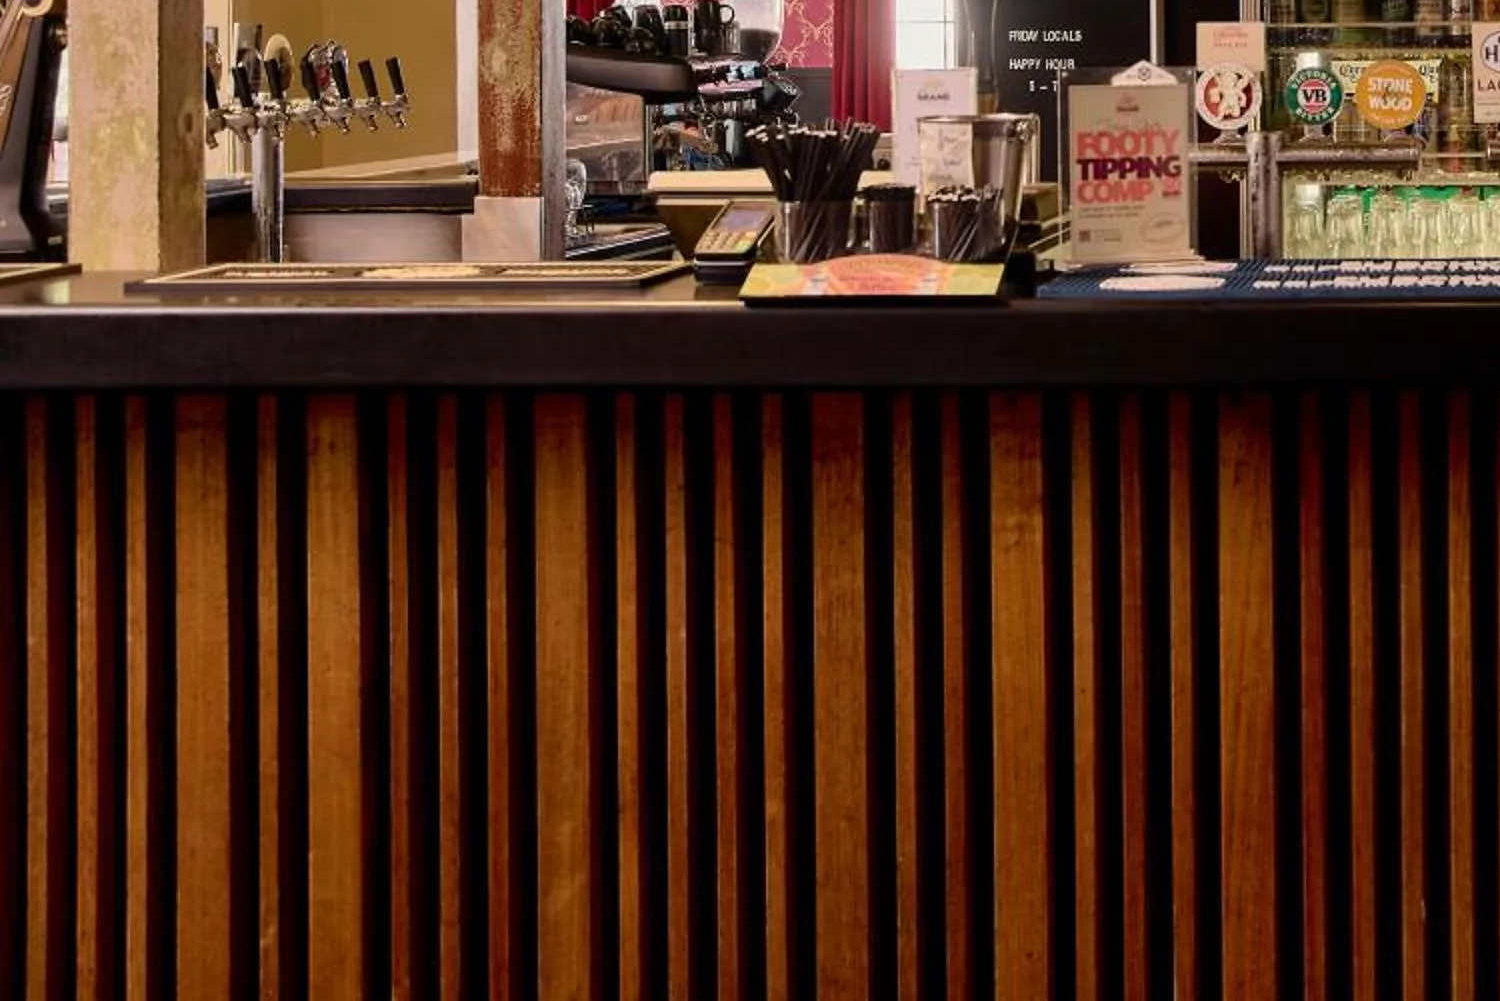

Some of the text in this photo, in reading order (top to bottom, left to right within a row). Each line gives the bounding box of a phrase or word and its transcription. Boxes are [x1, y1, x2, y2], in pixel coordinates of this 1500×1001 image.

[1043, 30, 1083, 42] LOCALS
[1009, 58, 1075, 70] HAPPY HOUR
[1367, 76, 1414, 94] STONE
[1302, 88, 1327, 103] VB
[1369, 96, 1413, 112] WOOD
[1077, 130, 1181, 156] FOOTY
[1077, 156, 1182, 181] TIPPING
[1077, 181, 1154, 204] COMP
